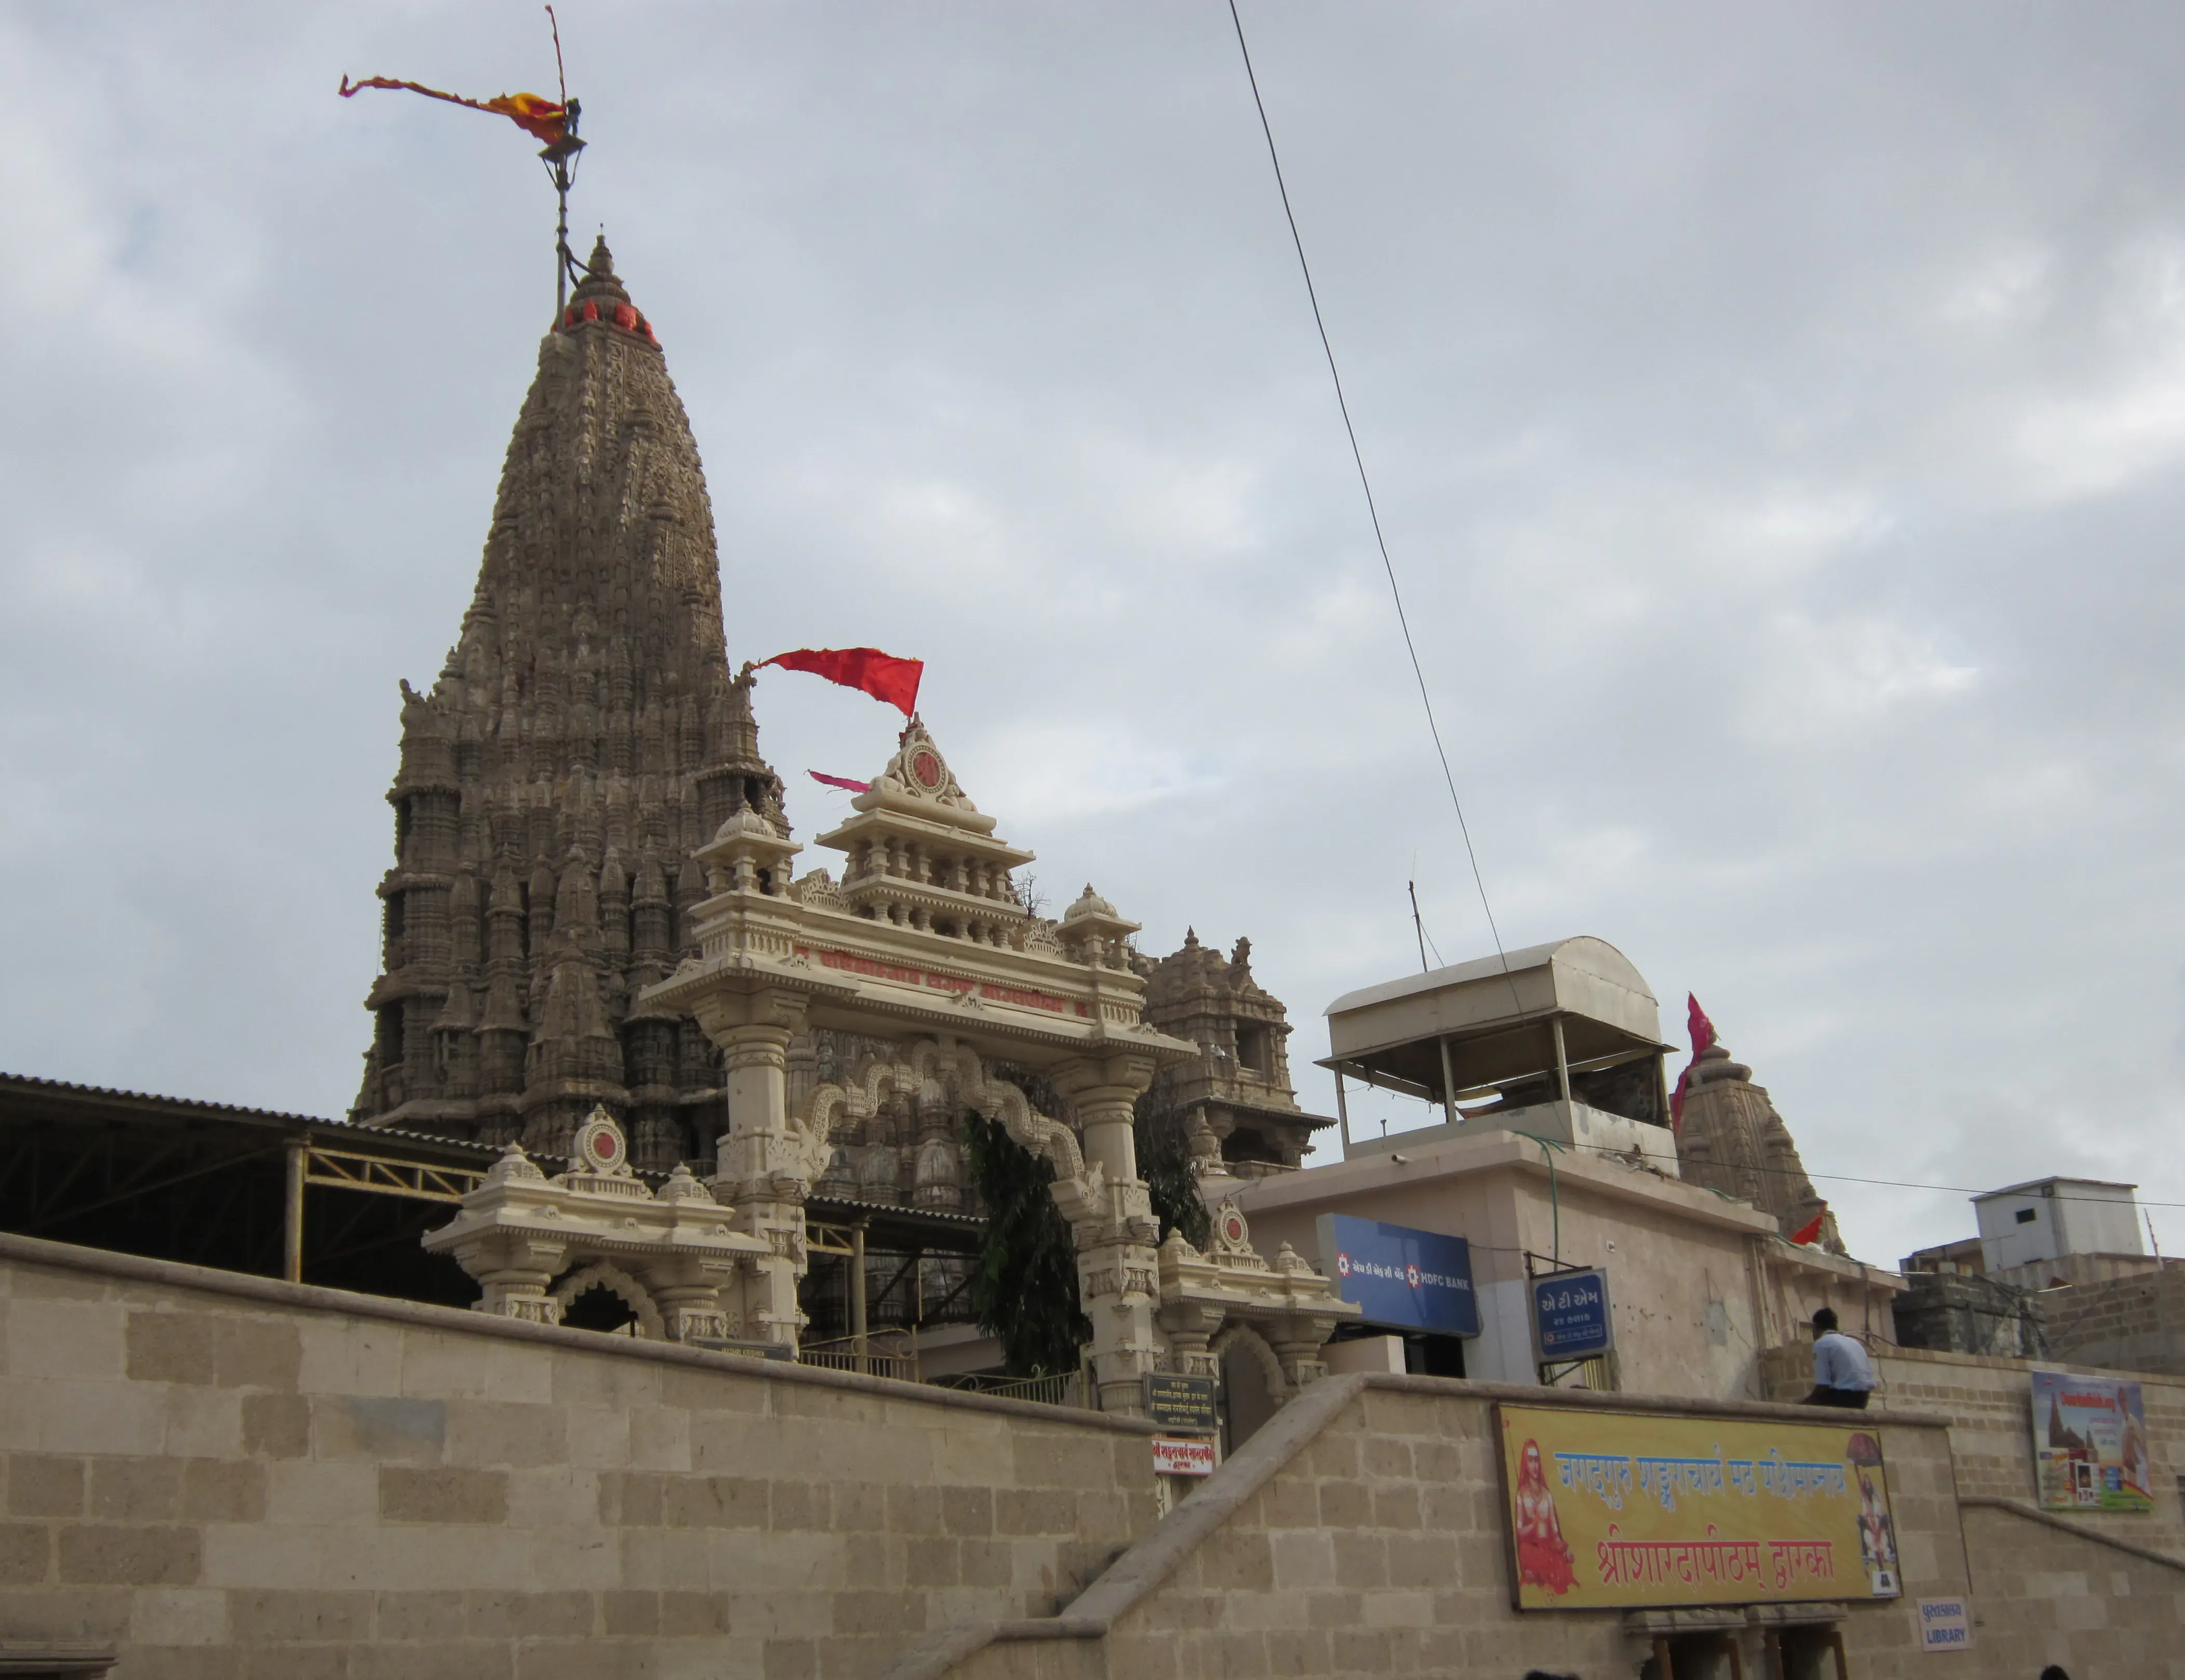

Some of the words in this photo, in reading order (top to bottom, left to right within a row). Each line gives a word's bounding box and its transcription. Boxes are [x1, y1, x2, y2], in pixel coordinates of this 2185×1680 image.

[1420, 1272, 1444, 1287] HDFC
[1446, 1276, 1470, 1291] BANK
[1541, 1293, 1556, 1311] એ
[1559, 1291, 1571, 1309] ટી
[1574, 1287, 1598, 1306] એમ
[1726, 1459, 1756, 1496] मठ
[1767, 1540, 1835, 1590] द्वारका
[1926, 1628, 1965, 1644] LIBRARY
